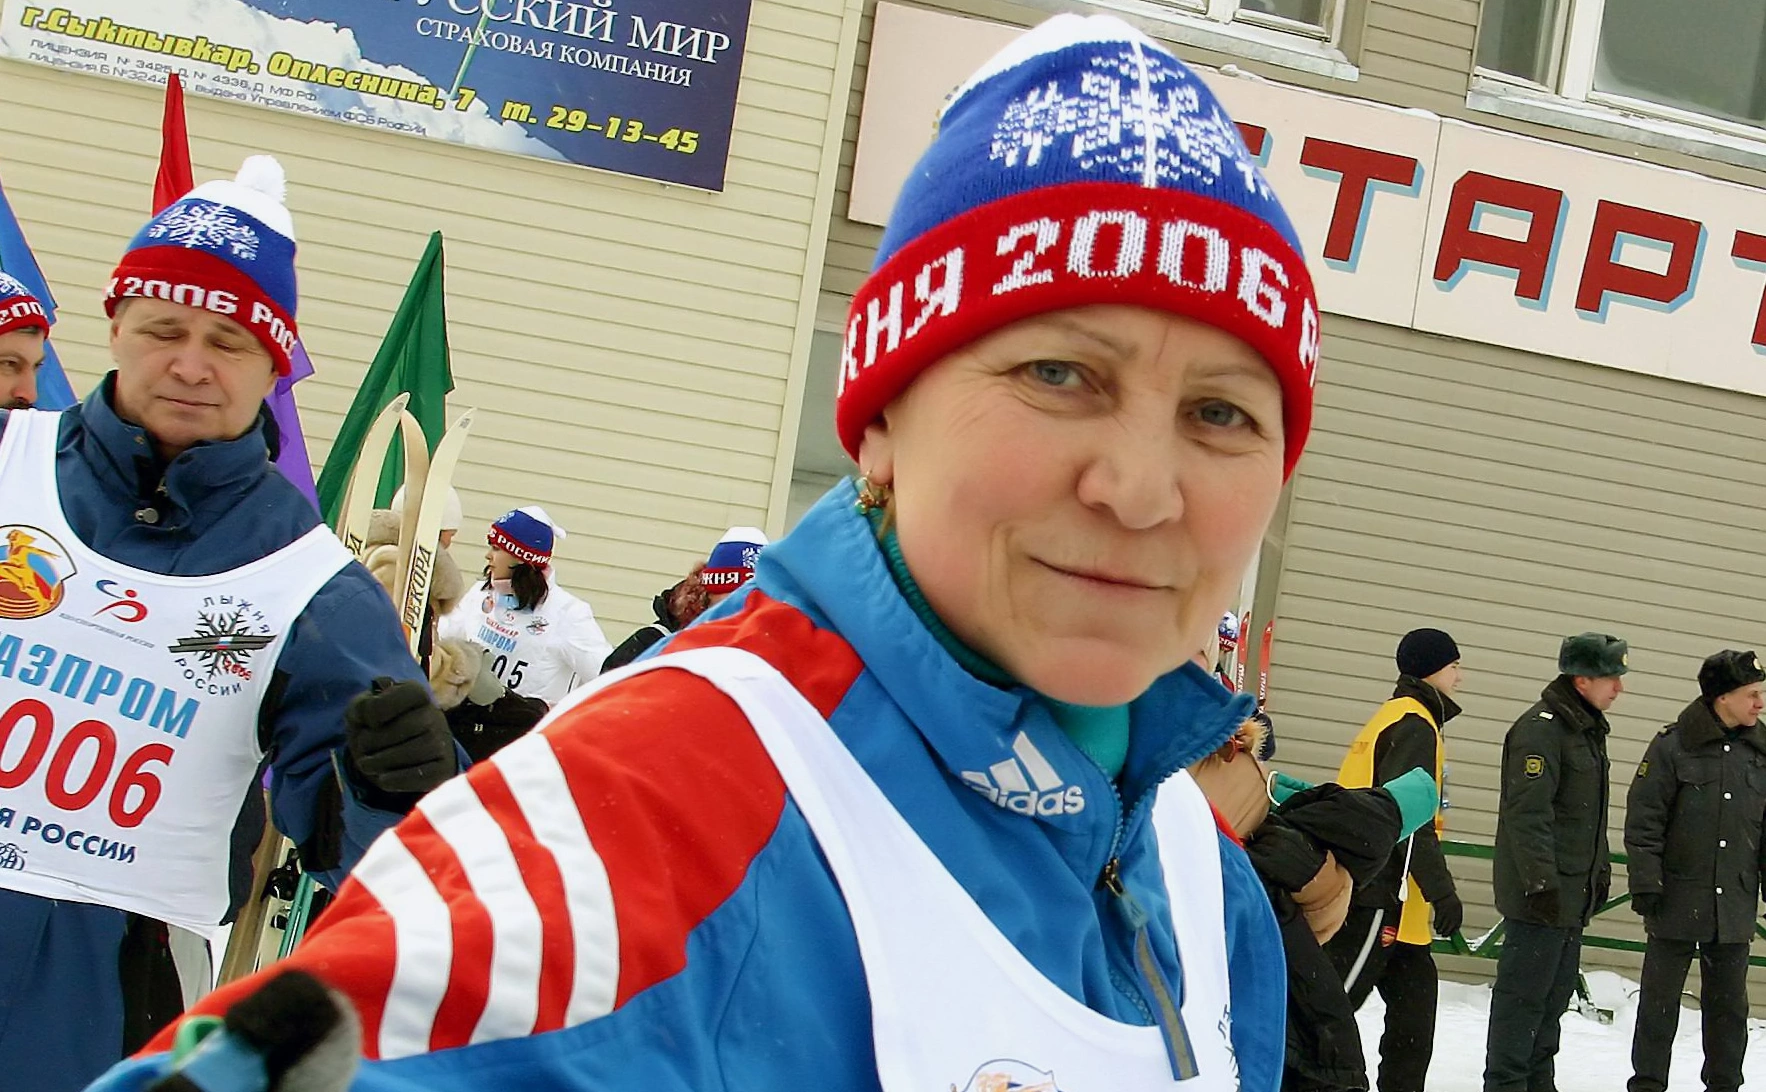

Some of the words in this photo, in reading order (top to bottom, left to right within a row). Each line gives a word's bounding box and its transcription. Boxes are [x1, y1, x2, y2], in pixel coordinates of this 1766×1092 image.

[416, 17, 555, 60] СТРАХОВАЯ
[559, 44, 693, 88] КОМПАНИЯ
[417, 0, 619, 43] СКИЙ
[631, 15, 730, 65] МИР
[267, 51, 446, 112] Оплеснина,
[455, 87, 477, 112] 7
[547, 105, 700, 155] 29-13-45
[1234, 121, 1766, 355] ТАР
[122, 276, 240, 315] 2006
[992, 208, 1290, 329] 2006
[203, 595, 270, 634] ЛЫЖНЯ
[174, 657, 243, 697] РОССИИ
[961, 778, 1086, 817] idas
[20, 815, 138, 864] РОССИИ
